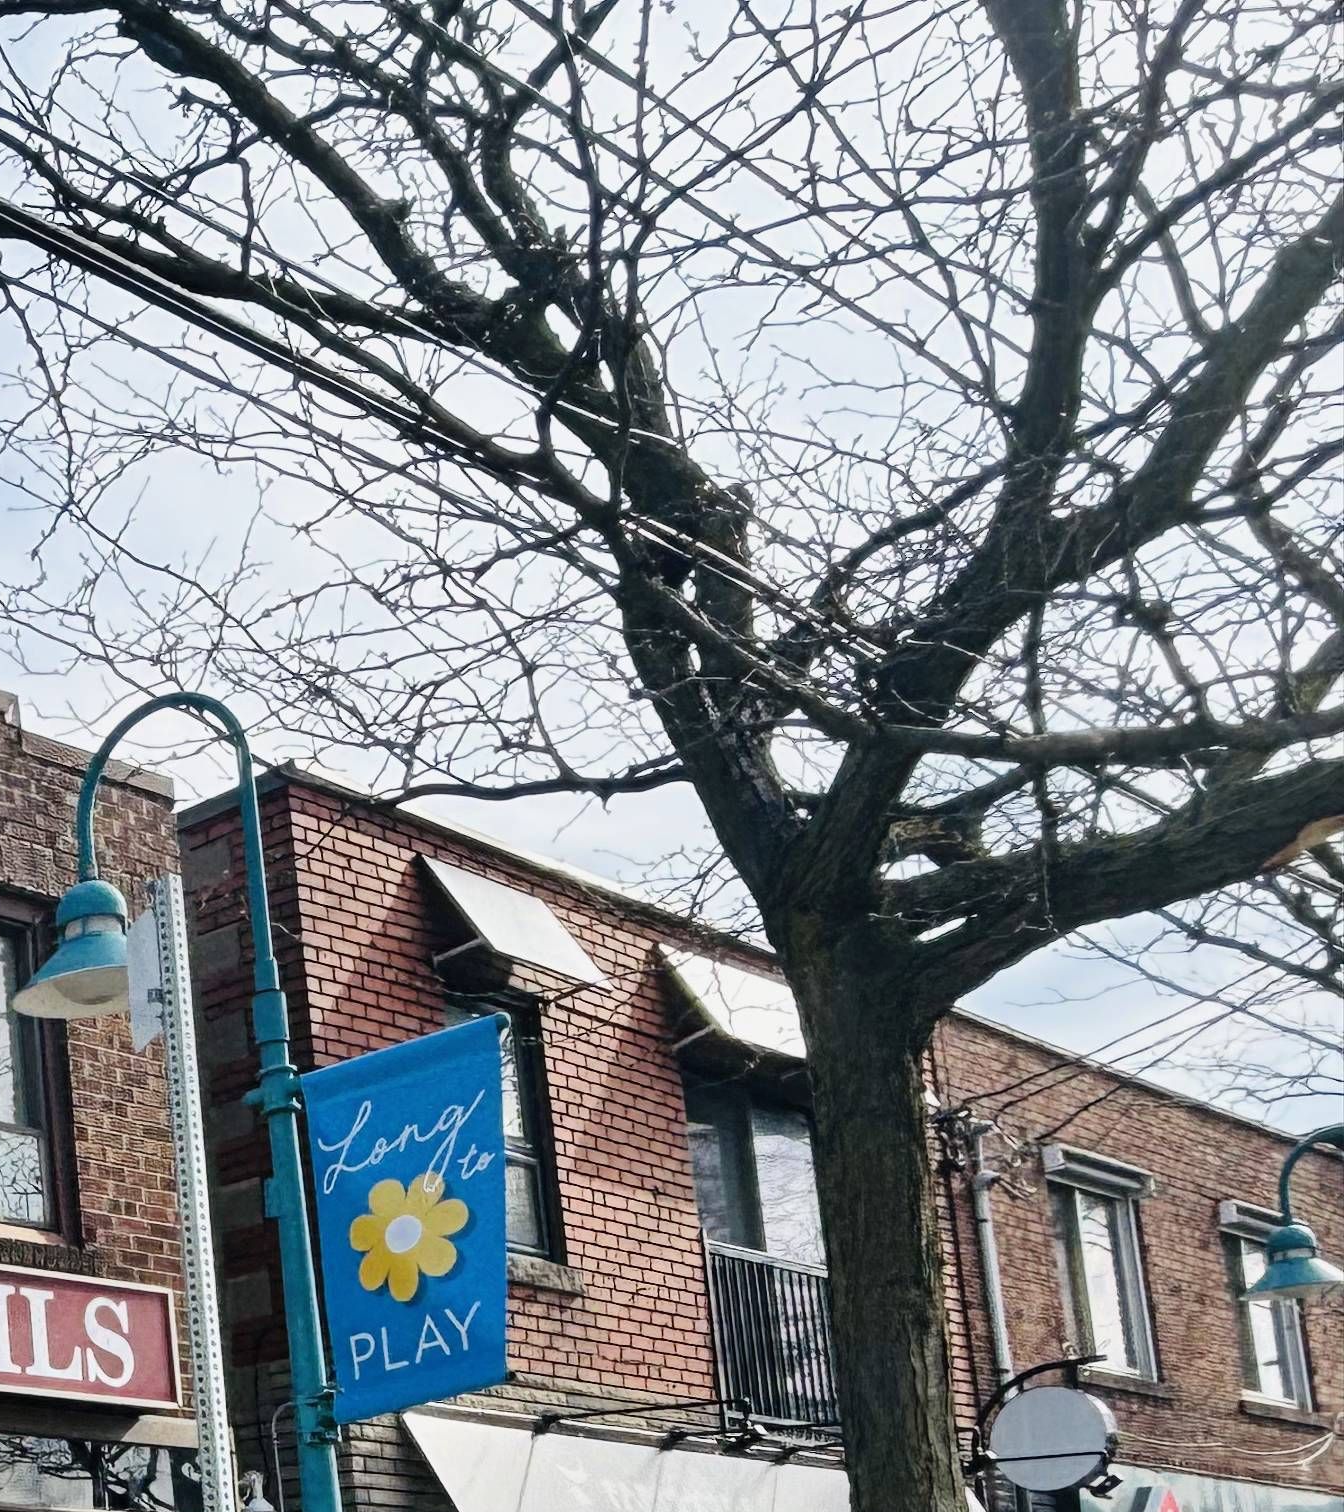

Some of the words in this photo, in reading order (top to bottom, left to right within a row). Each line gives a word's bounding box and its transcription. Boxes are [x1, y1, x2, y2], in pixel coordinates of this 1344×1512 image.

[318, 1089, 486, 1194] Long
[457, 1143, 496, 1180] to
[349, 1301, 481, 1380] PLAY
